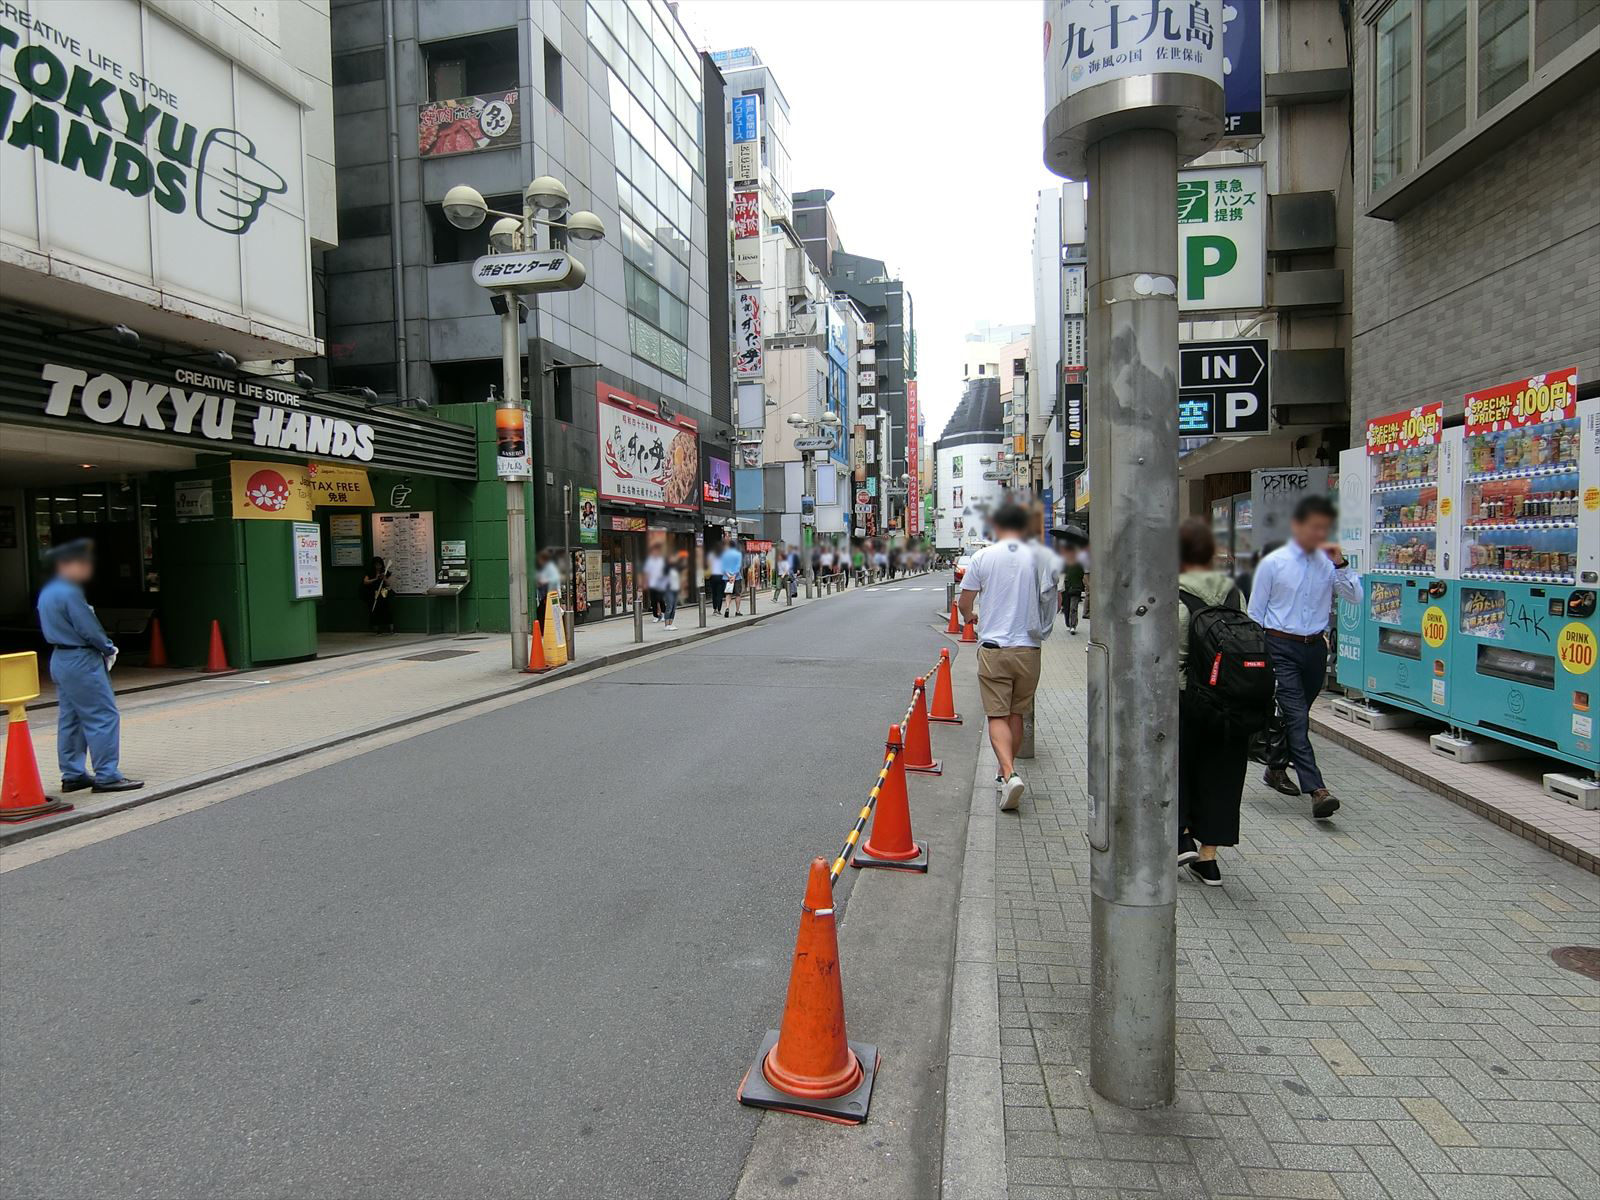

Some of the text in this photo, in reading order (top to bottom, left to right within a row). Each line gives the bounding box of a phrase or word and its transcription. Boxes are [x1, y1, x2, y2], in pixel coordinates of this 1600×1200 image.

[1061, 0, 1214, 70] 九十九島
[1088, 46, 1203, 74] 海風の国 佐世保市
[87, 48, 123, 79] LIFE
[128, 71, 178, 110] STORE
[1214, 179, 1243, 193] 東急
[1214, 192, 1256, 207] ハンズ
[1214, 207, 1243, 222] 提携
[478, 258, 565, 277] 渋谷センター街
[1186, 235, 1238, 300] P
[1201, 355, 1237, 380] IN
[175, 369, 300, 407] CREATIVE LIFE STORE
[1517, 381, 1568, 417] 100円
[41, 363, 375, 462] TOKYU HANDS
[1179, 400, 1208, 429] 空
[1226, 392, 1258, 428] P
[1471, 394, 1512, 414] SPECIAL
[1068, 400, 1081, 446] DOUTOR
[1371, 421, 1400, 436] SPECIAL
[1402, 413, 1438, 438] 100円
[310, 481, 333, 492] TAX
[337, 482, 361, 492] FREE
[328, 493, 348, 503] 免税
[1427, 613, 1443, 623] DRINK
[1424, 623, 1444, 640] ¥100
[1566, 631, 1589, 644] DRINK
[1340, 644, 1360, 661] SALE!
[1561, 643, 1592, 665] ¥100
